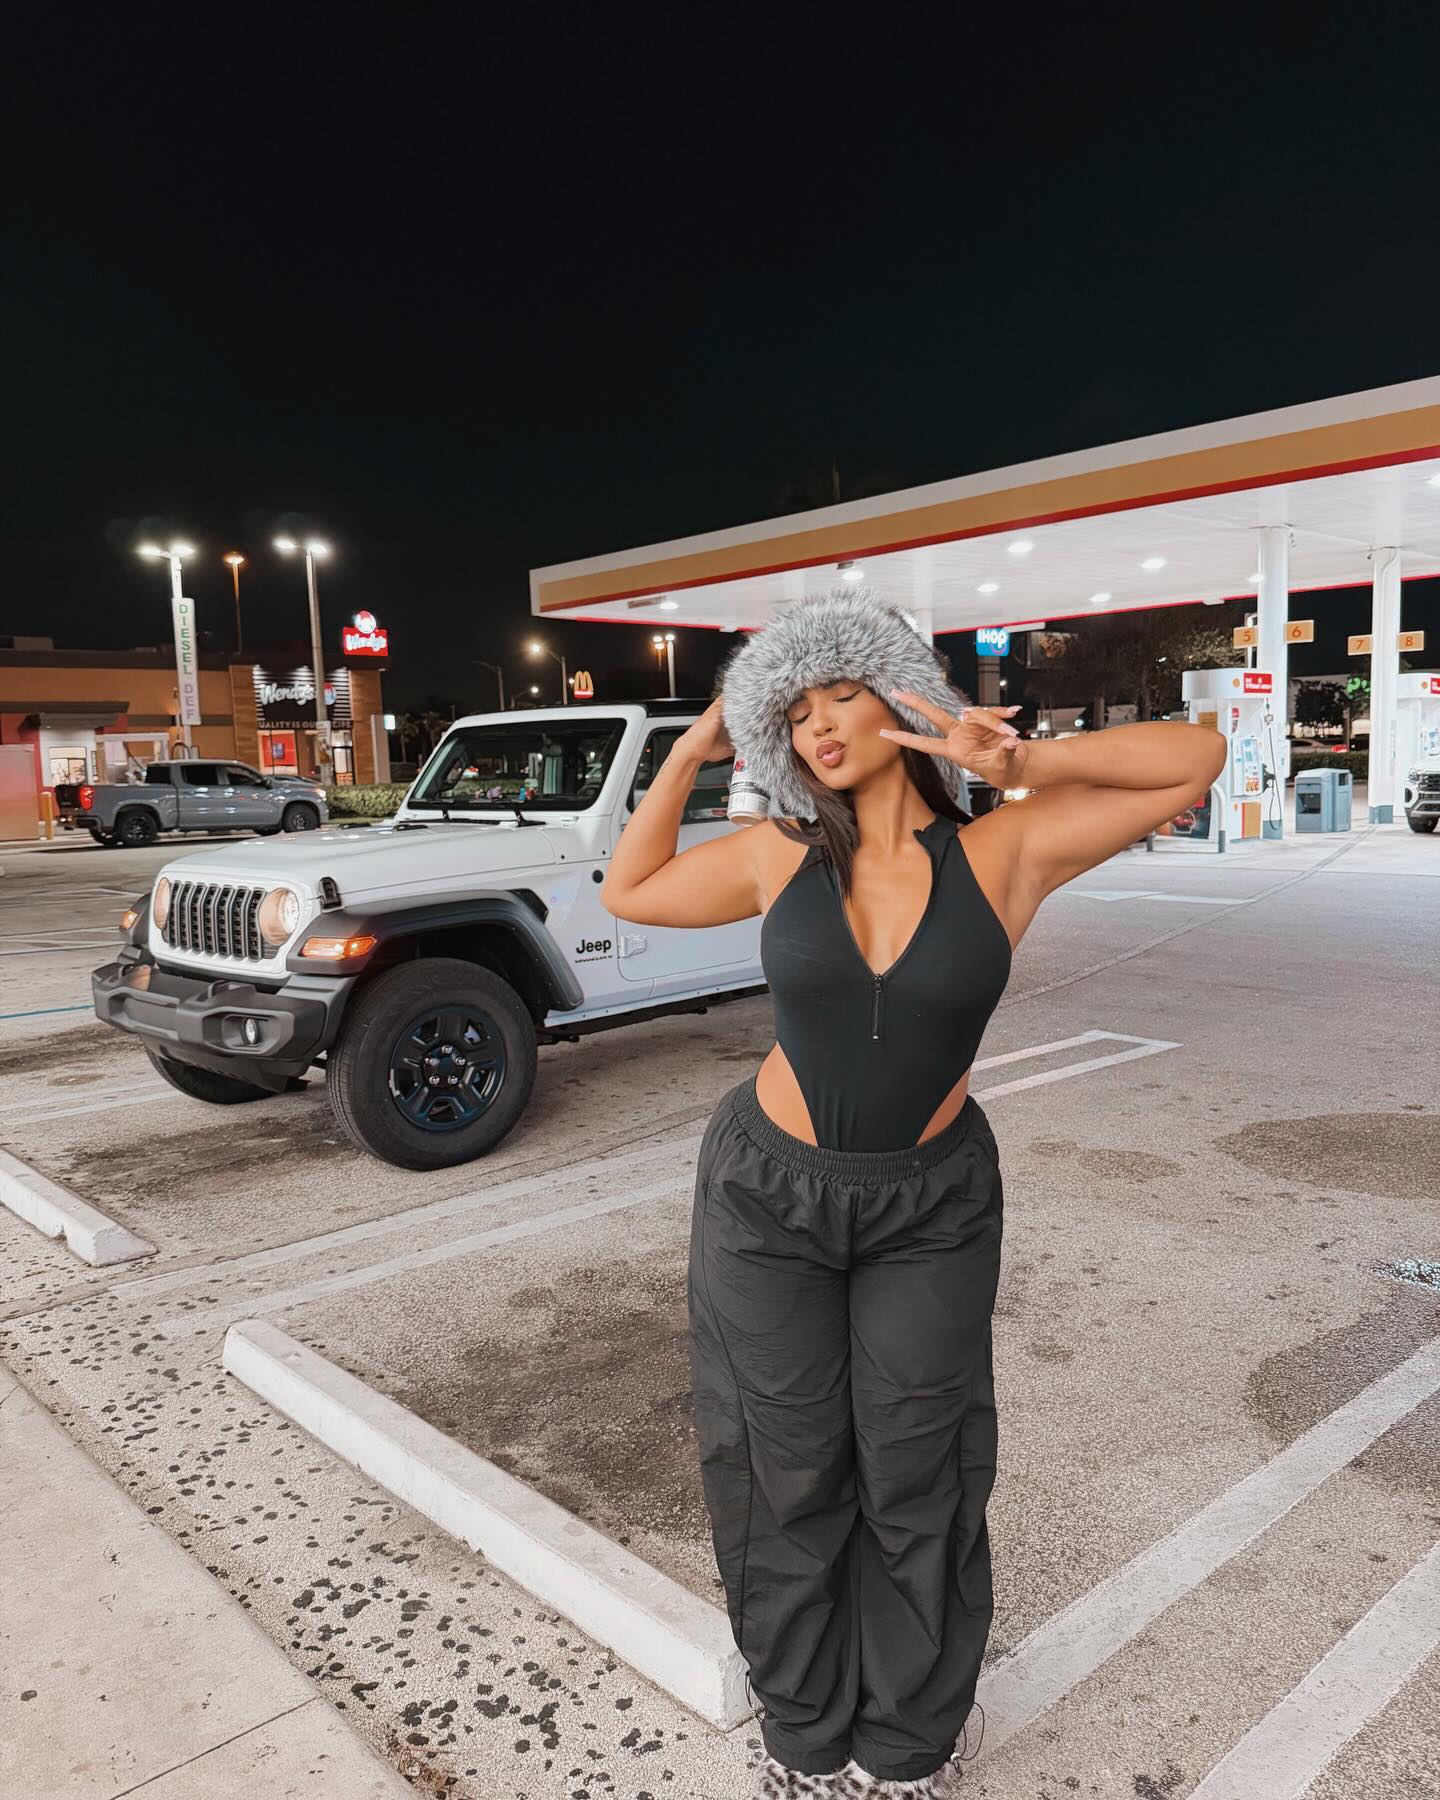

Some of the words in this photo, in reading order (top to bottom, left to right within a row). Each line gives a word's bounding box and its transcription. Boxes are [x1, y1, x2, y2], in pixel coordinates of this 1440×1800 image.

[1243, 630, 1251, 642] 5
[1292, 626, 1302, 638] 6
[179, 604, 193, 675] DIESEL
[1355, 639, 1365, 650] 7
[1404, 635, 1414, 647] 8
[260, 682, 316, 706] Wendy's
[184, 683, 195, 719] DEF
[576, 939, 612, 954] Jeep
